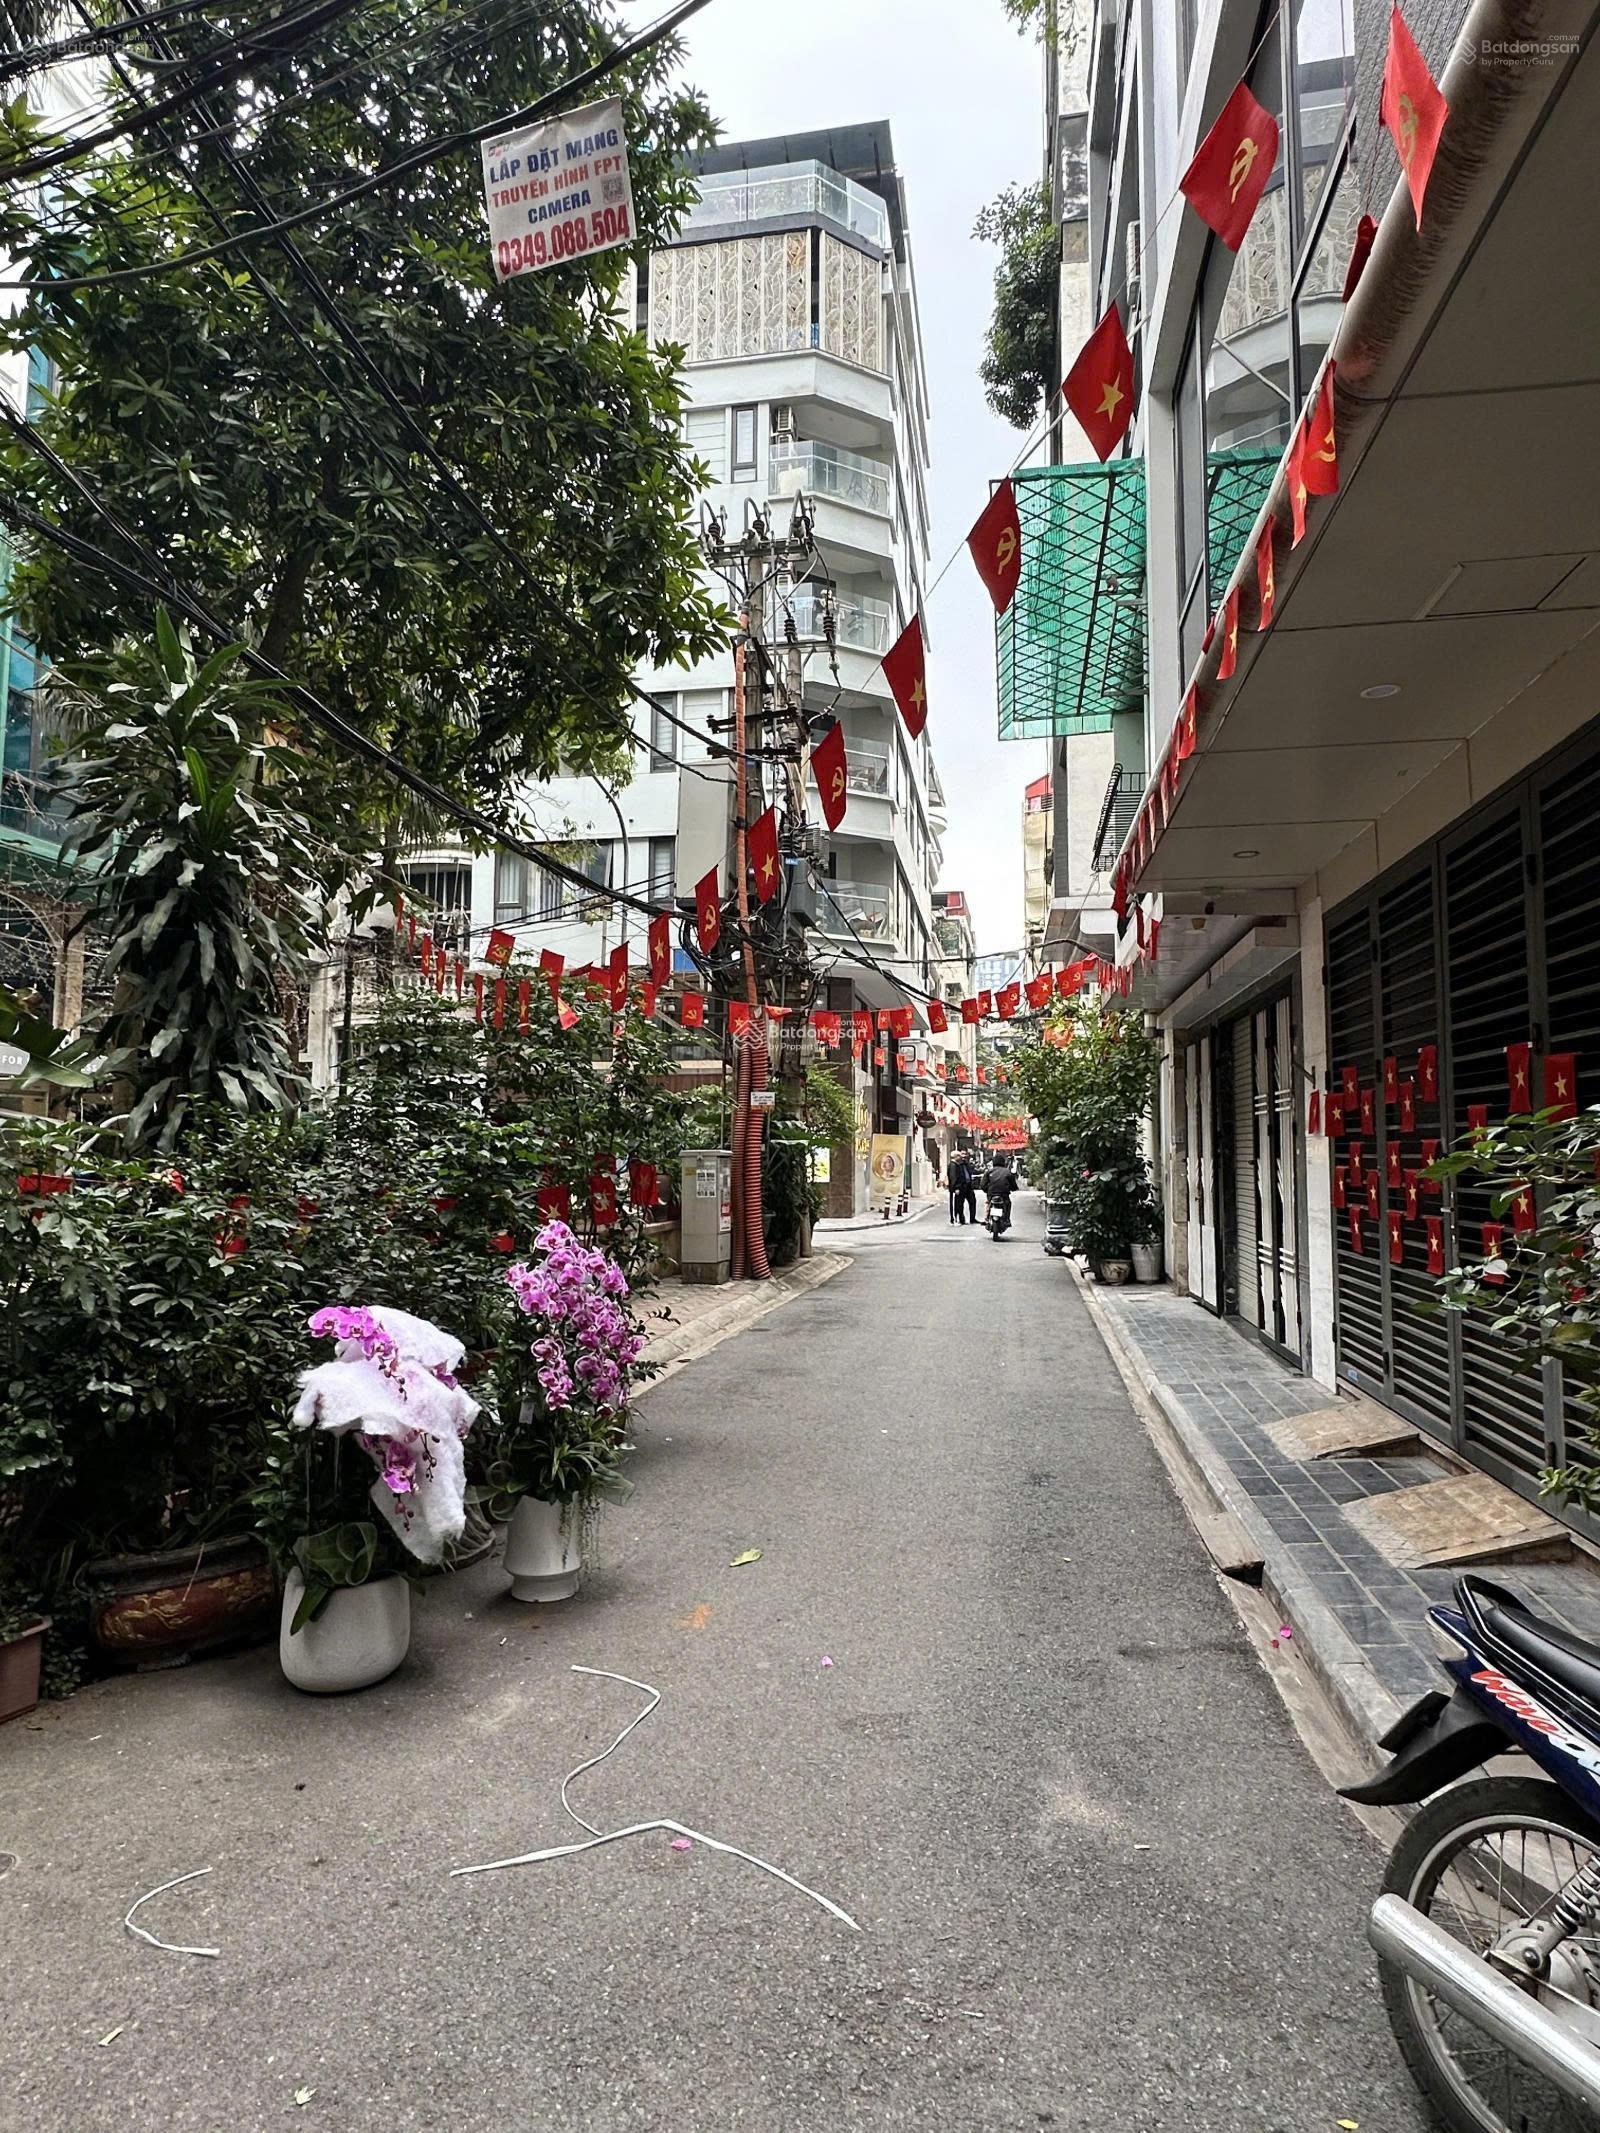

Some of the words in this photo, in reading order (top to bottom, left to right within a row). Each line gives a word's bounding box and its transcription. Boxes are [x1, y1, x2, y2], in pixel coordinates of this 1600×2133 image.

[527, 147, 559, 173] ĐẶT
[565, 129, 619, 161] MẠNG
[491, 177, 549, 208] TRUYỀN
[554, 164, 589, 191] HÌNH
[594, 155, 622, 176] FPT
[528, 189, 592, 224] CAMERA
[497, 207, 631, 275] 0349.088.504
[1470, 1669, 1568, 1742] Wave
